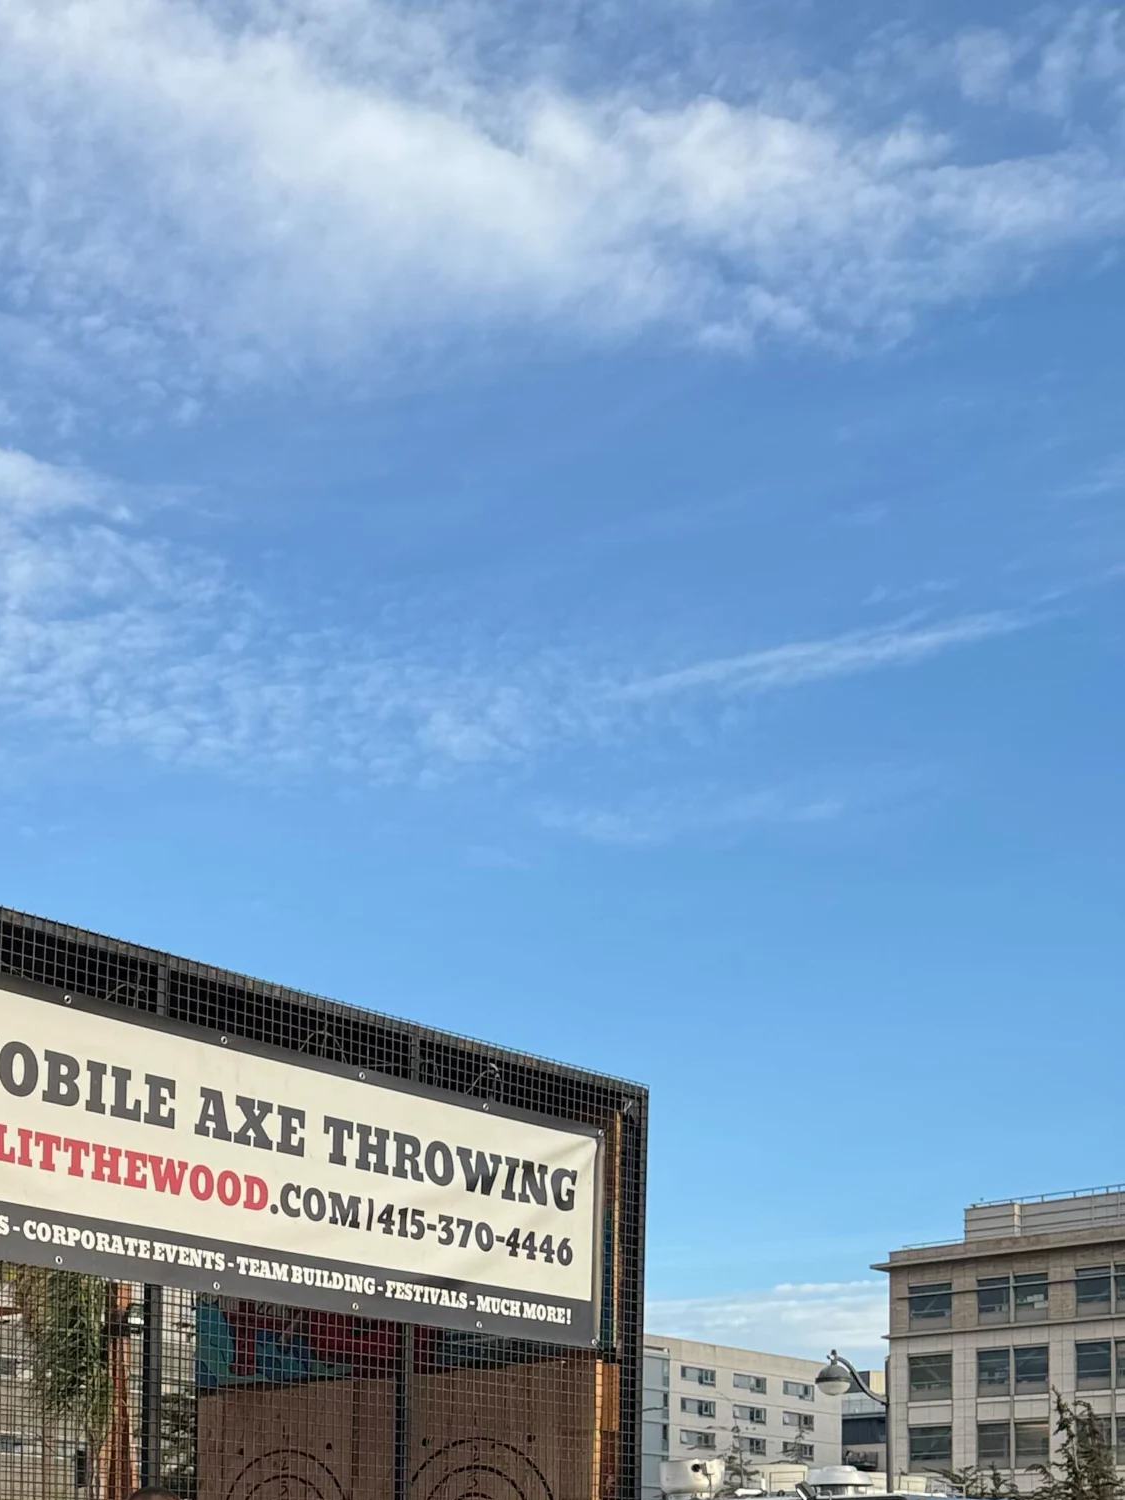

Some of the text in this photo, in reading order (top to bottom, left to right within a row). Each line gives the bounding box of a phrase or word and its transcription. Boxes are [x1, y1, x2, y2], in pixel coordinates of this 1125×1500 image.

[194, 1086, 306, 1157] AXE
[323, 1115, 577, 1211] THROWING
[23, 1220, 150, 1259] CORPORATE
[152, 1242, 225, 1272] EVENTS
[236, 1256, 289, 1281] TEAM
[291, 1265, 376, 1295] BUILDING
[385, 1281, 468, 1309] FESTIVALS
[476, 1296, 521, 1317] MUCH
[523, 1302, 572, 1325] MORE!
